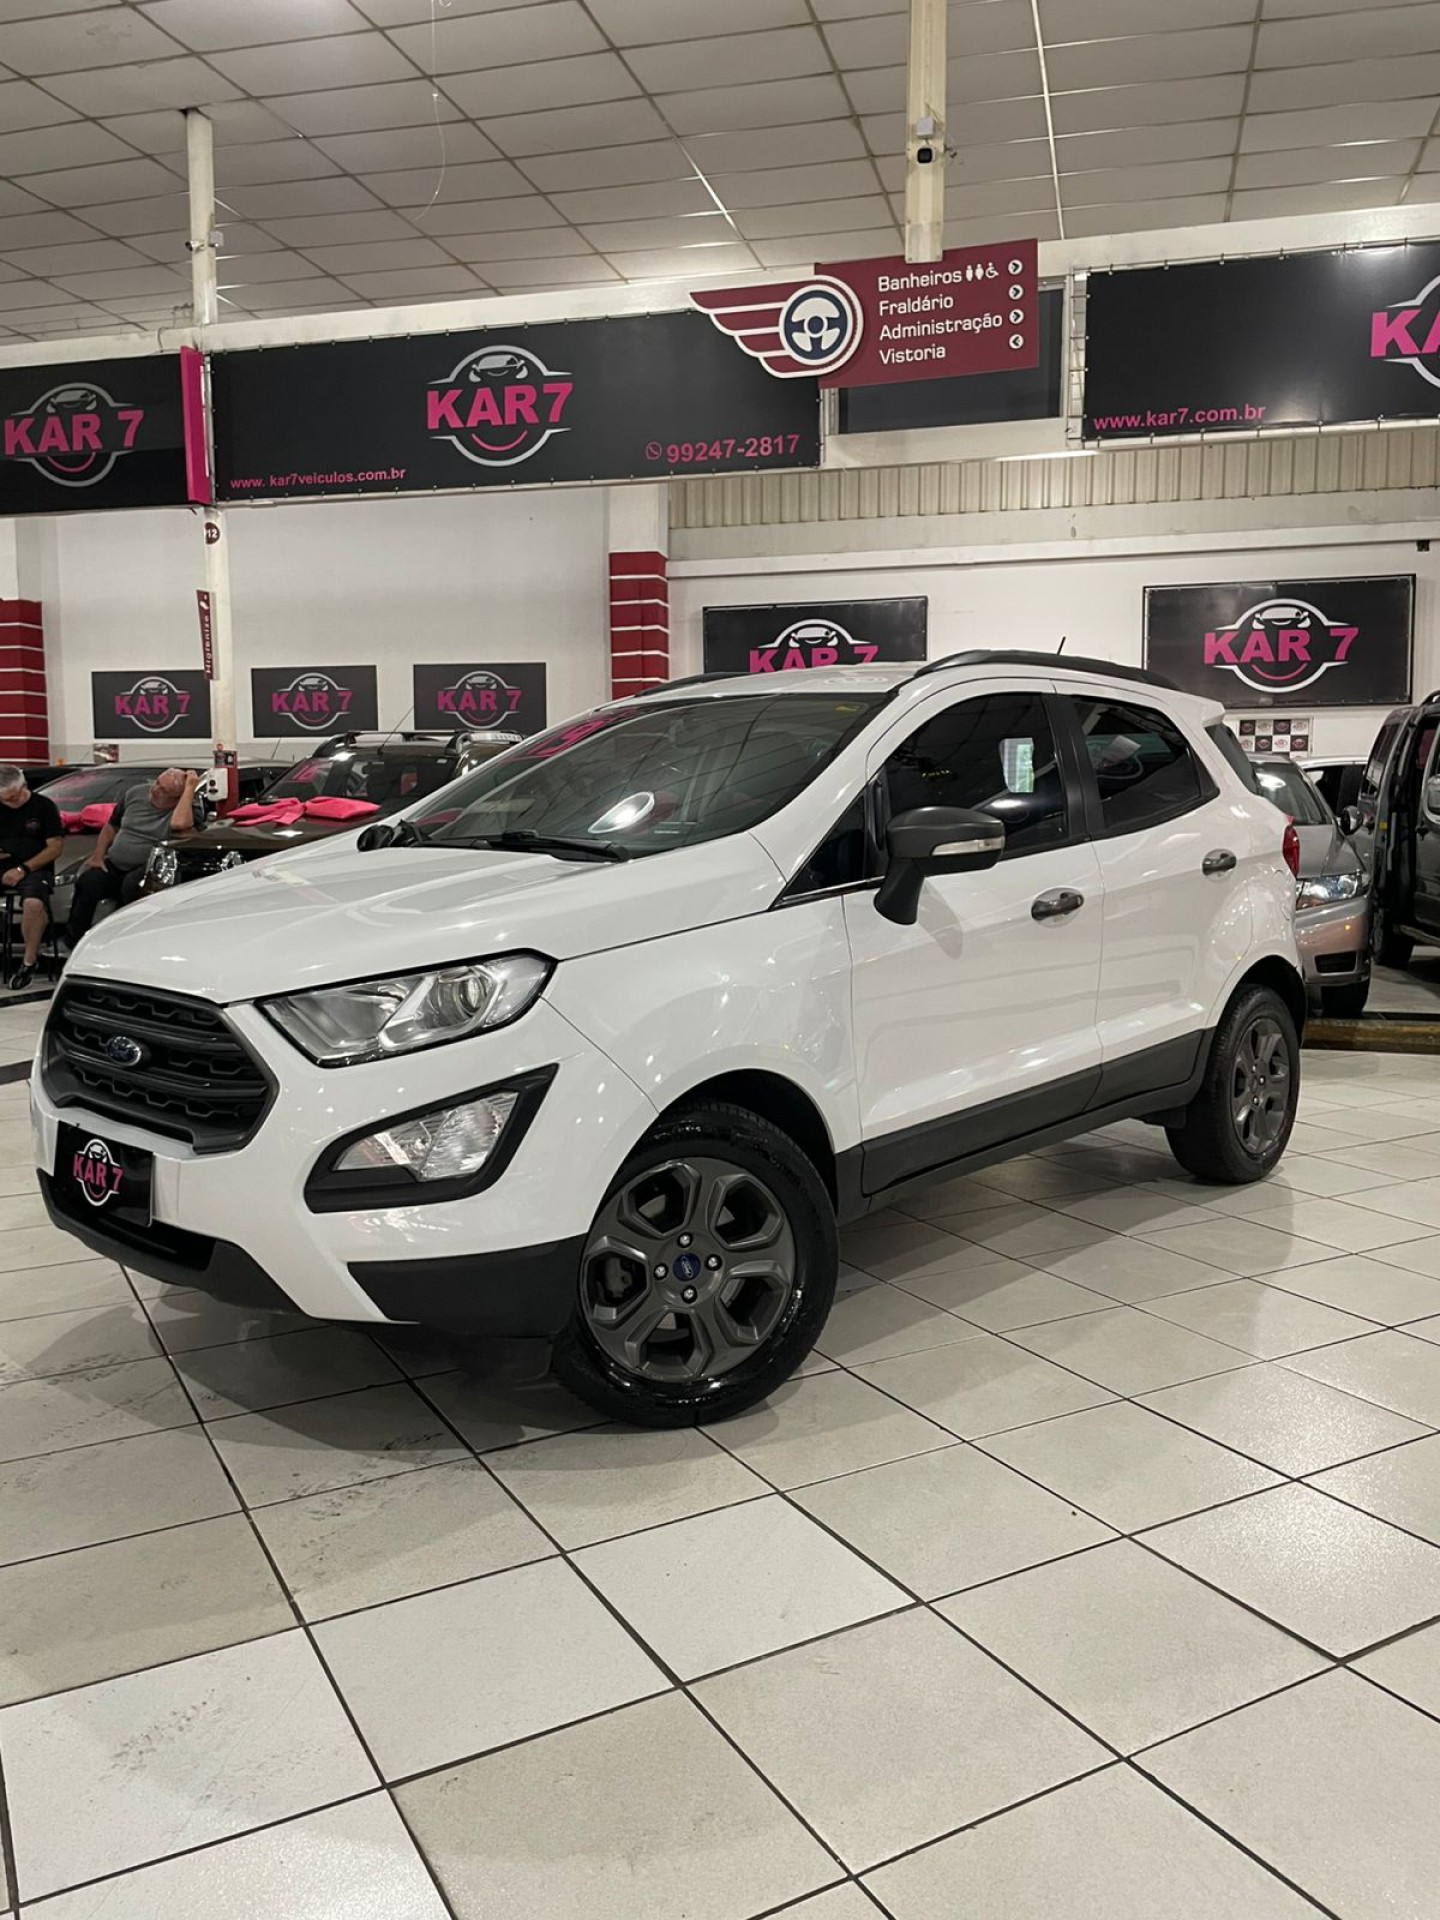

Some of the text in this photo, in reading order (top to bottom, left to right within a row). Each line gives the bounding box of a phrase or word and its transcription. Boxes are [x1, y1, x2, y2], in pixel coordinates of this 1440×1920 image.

[878, 271, 962, 292] Banheiros
[878, 296, 954, 316] Fraldário
[878, 314, 1003, 341] Administração
[878, 345, 946, 365] Vistoria
[1093, 404, 1266, 431] www.kar7.com.br
[4, 409, 144, 456] KAR 7
[666, 433, 800, 463] 99247-2817
[1203, 627, 1360, 665] KAR 7
[114, 694, 192, 716] KAR 7
[271, 690, 352, 712] KAR 7
[437, 690, 522, 711] KAR 7
[73, 1153, 124, 1192] KAR 7
